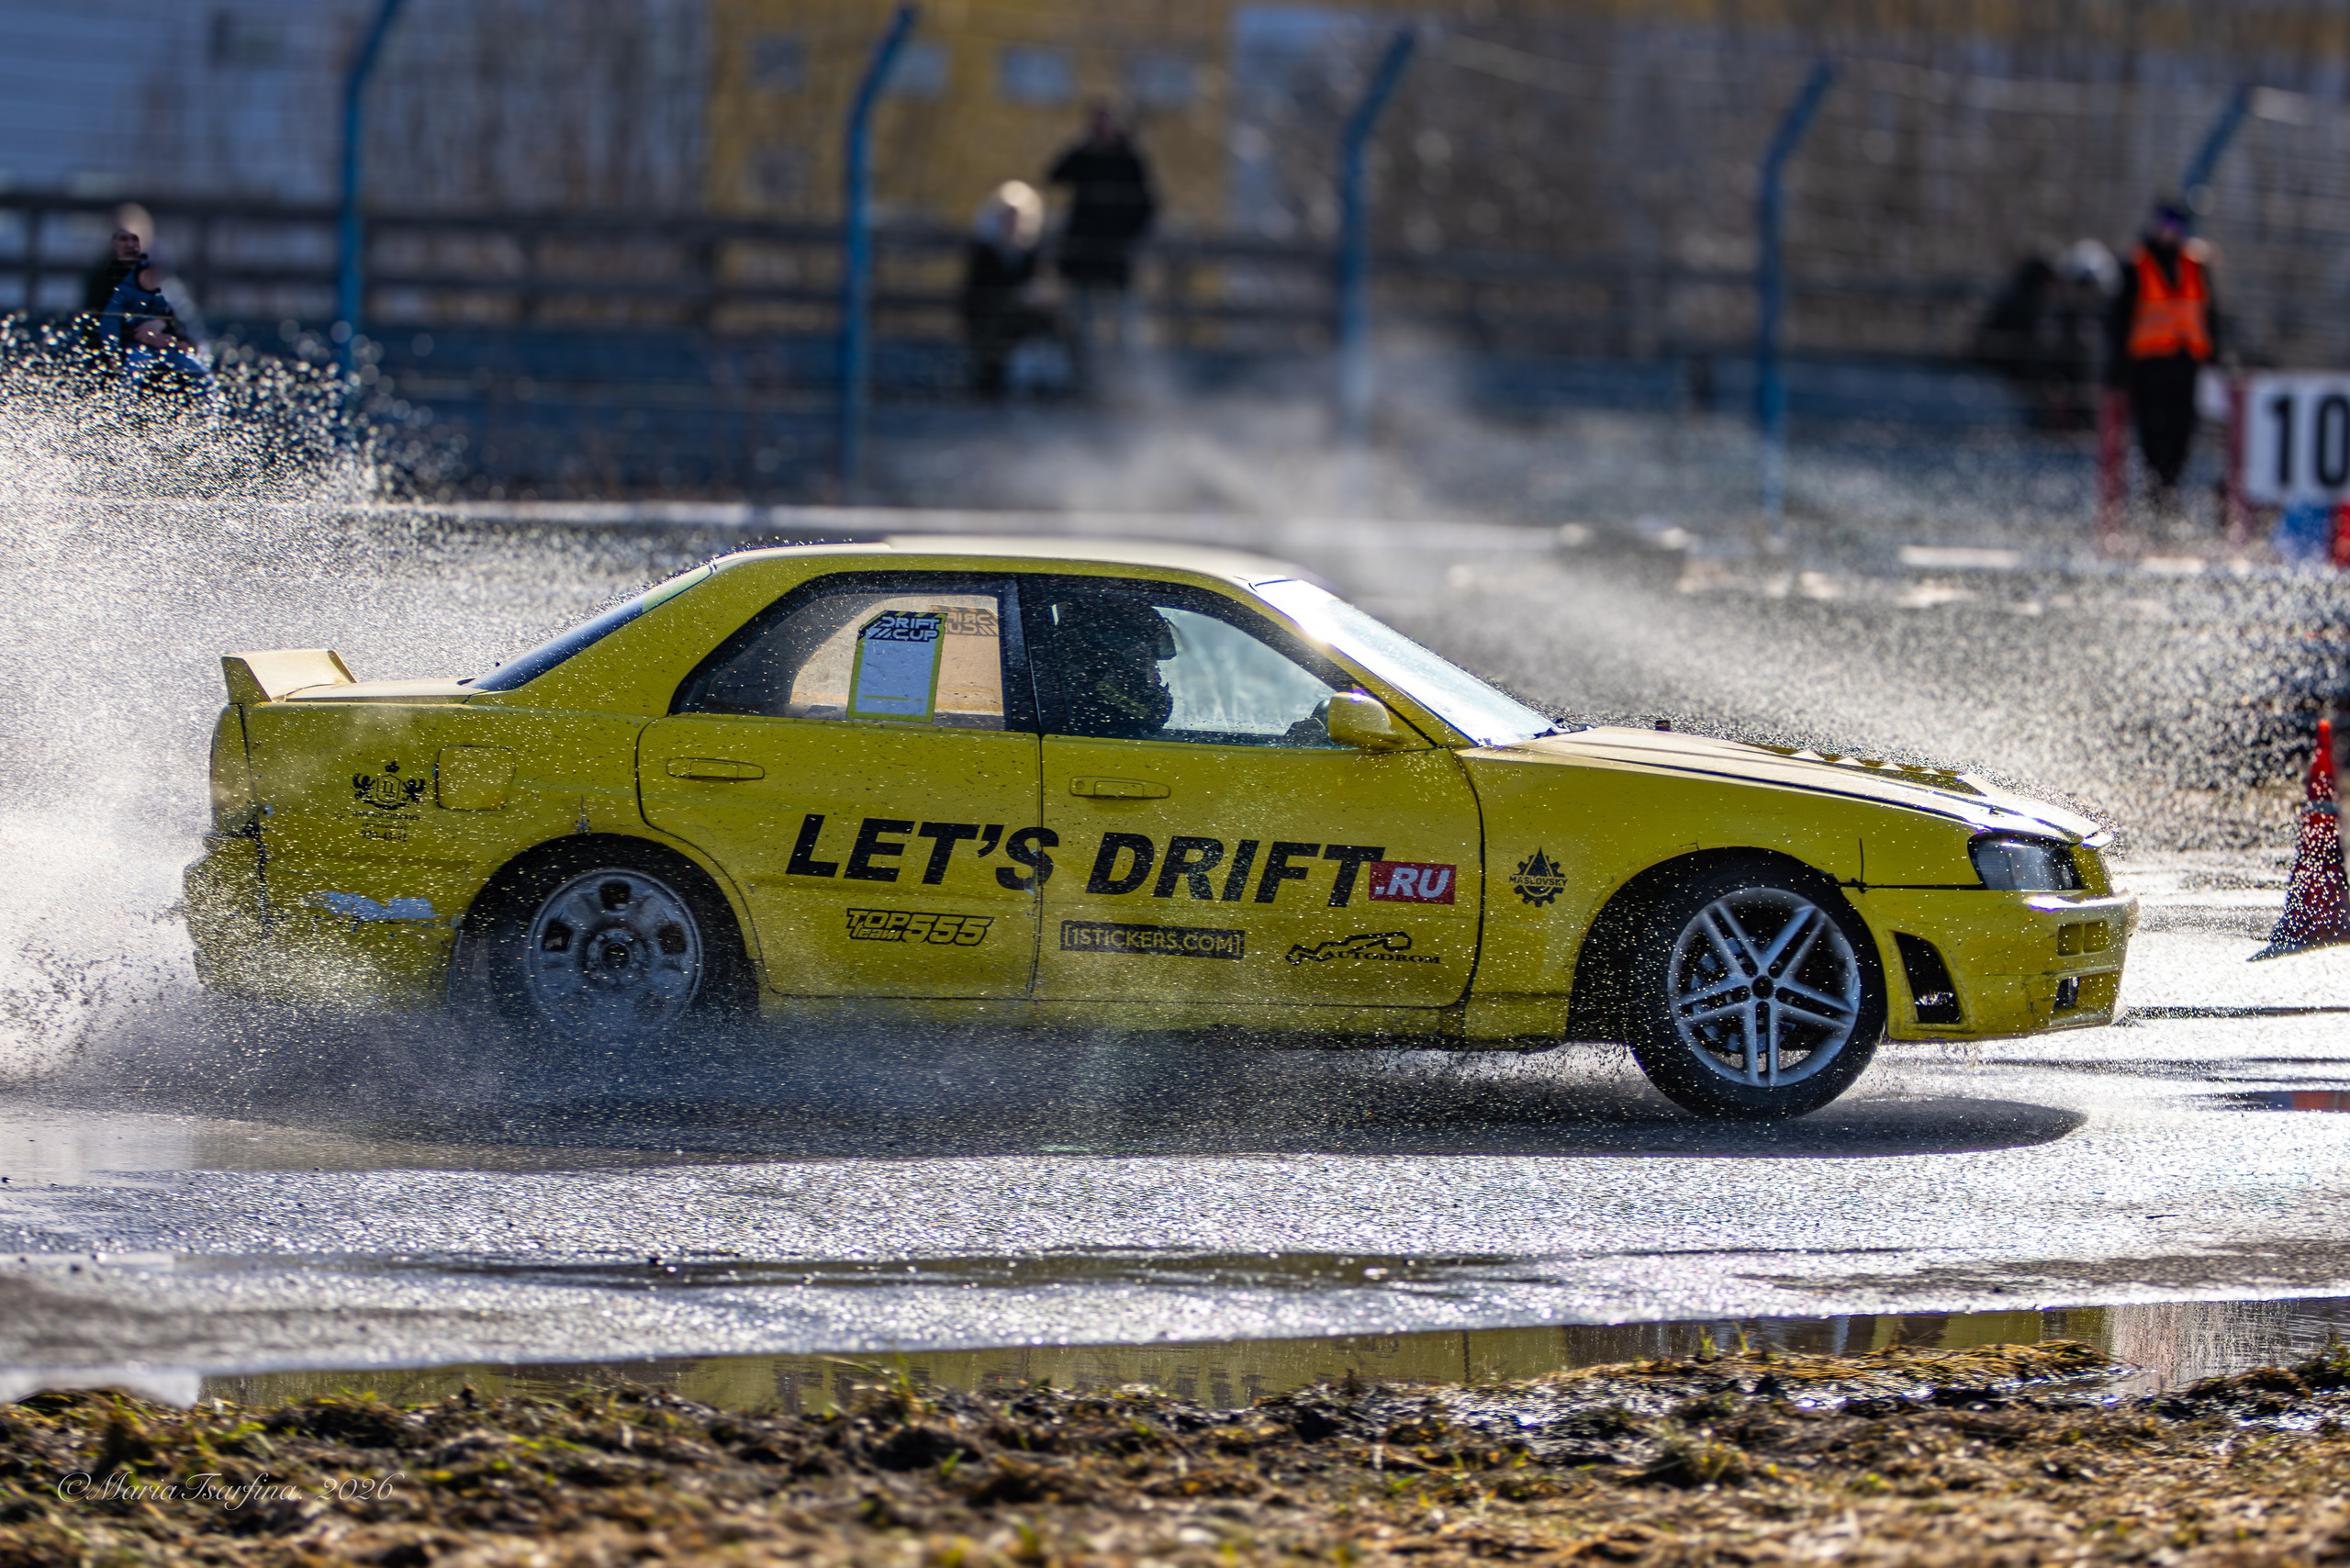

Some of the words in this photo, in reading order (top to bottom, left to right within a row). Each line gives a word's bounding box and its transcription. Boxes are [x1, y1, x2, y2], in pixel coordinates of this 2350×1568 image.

[881, 616, 940, 630] DRIFT
[892, 628, 939, 641] CUP
[785, 813, 1059, 891] LET'S
[1509, 875, 1568, 887] MASLOVSKY
[1325, 950, 1442, 964] AUTODROM
